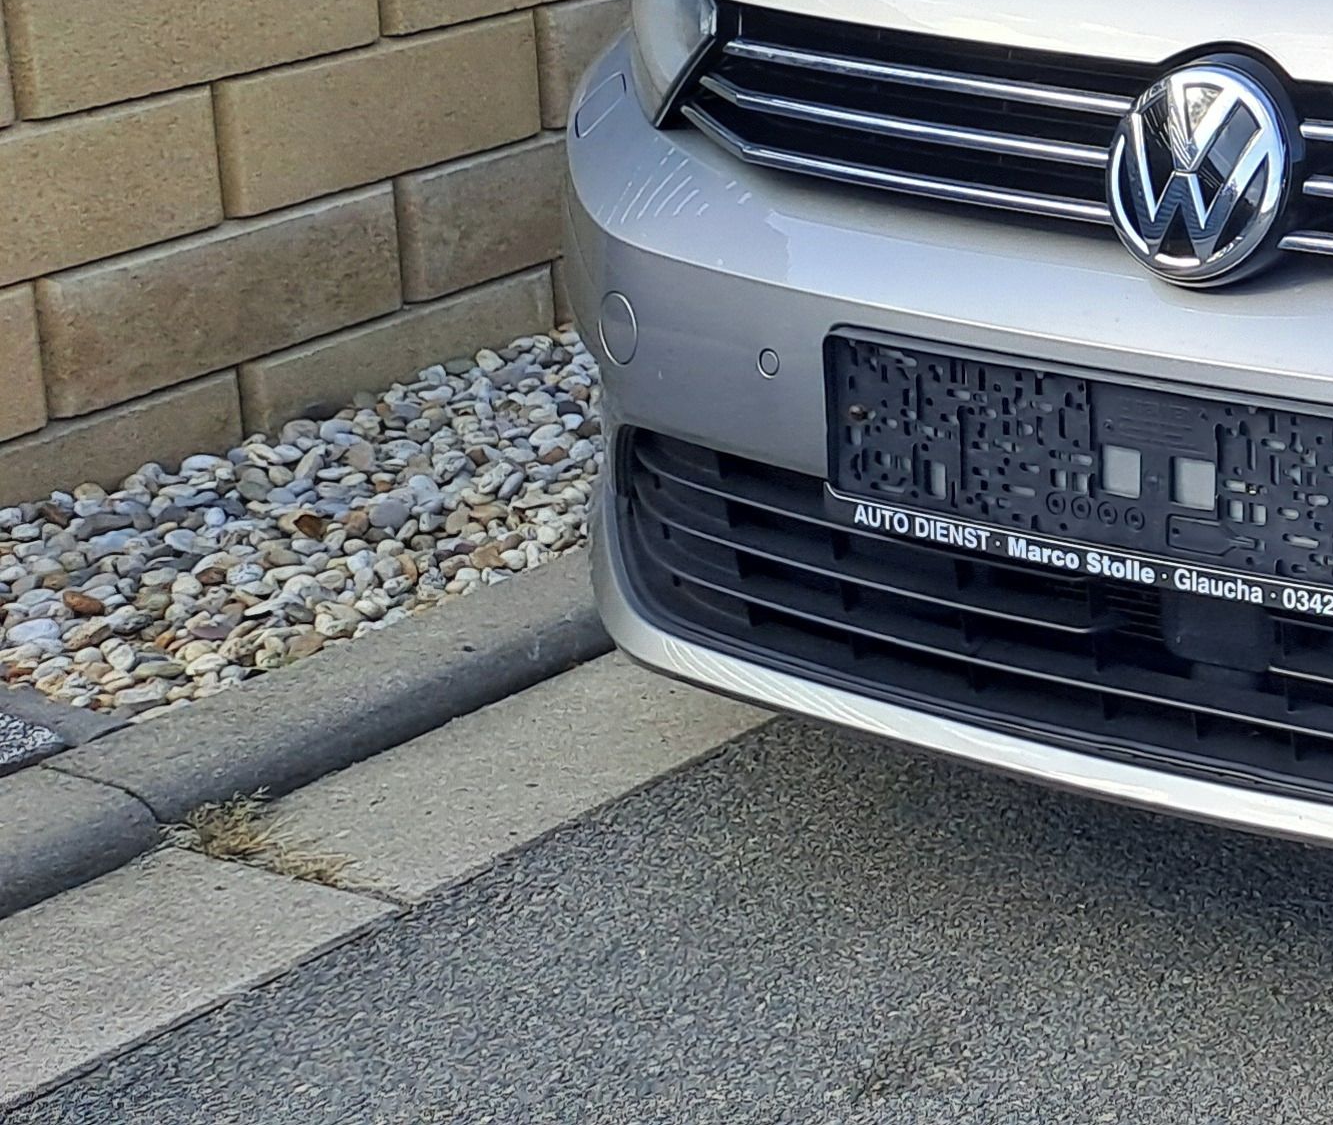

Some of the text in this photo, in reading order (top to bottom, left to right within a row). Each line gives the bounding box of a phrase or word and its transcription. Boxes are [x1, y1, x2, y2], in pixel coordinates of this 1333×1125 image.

[1108, 64, 1288, 280] VW
[854, 504, 909, 534] AUTO
[915, 517, 991, 551] DIENST
[1007, 536, 1080, 570] Marco
[1086, 552, 1156, 584] Stolle
[1174, 568, 1264, 604] Glaucha
